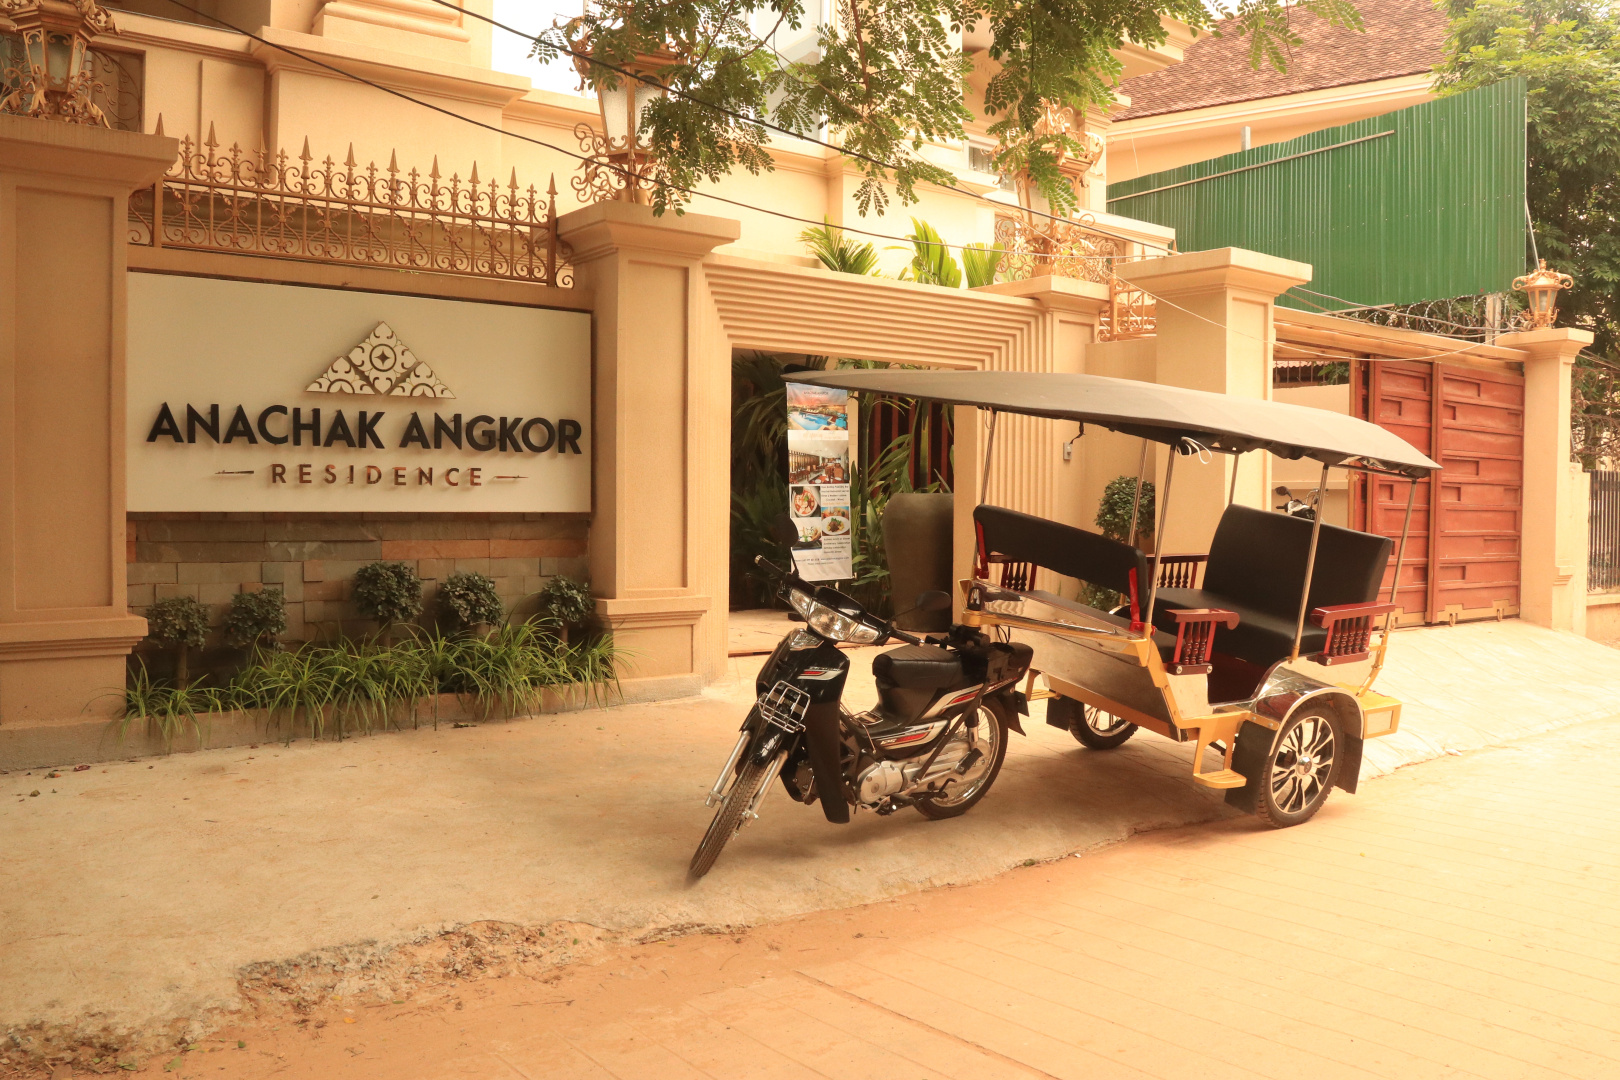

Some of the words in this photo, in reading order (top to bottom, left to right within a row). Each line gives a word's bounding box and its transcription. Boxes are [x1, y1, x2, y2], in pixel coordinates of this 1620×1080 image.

[146, 402, 385, 449] ANACHAK
[399, 411, 582, 454] ANGKOR
[271, 463, 482, 487] RESIDENCE
